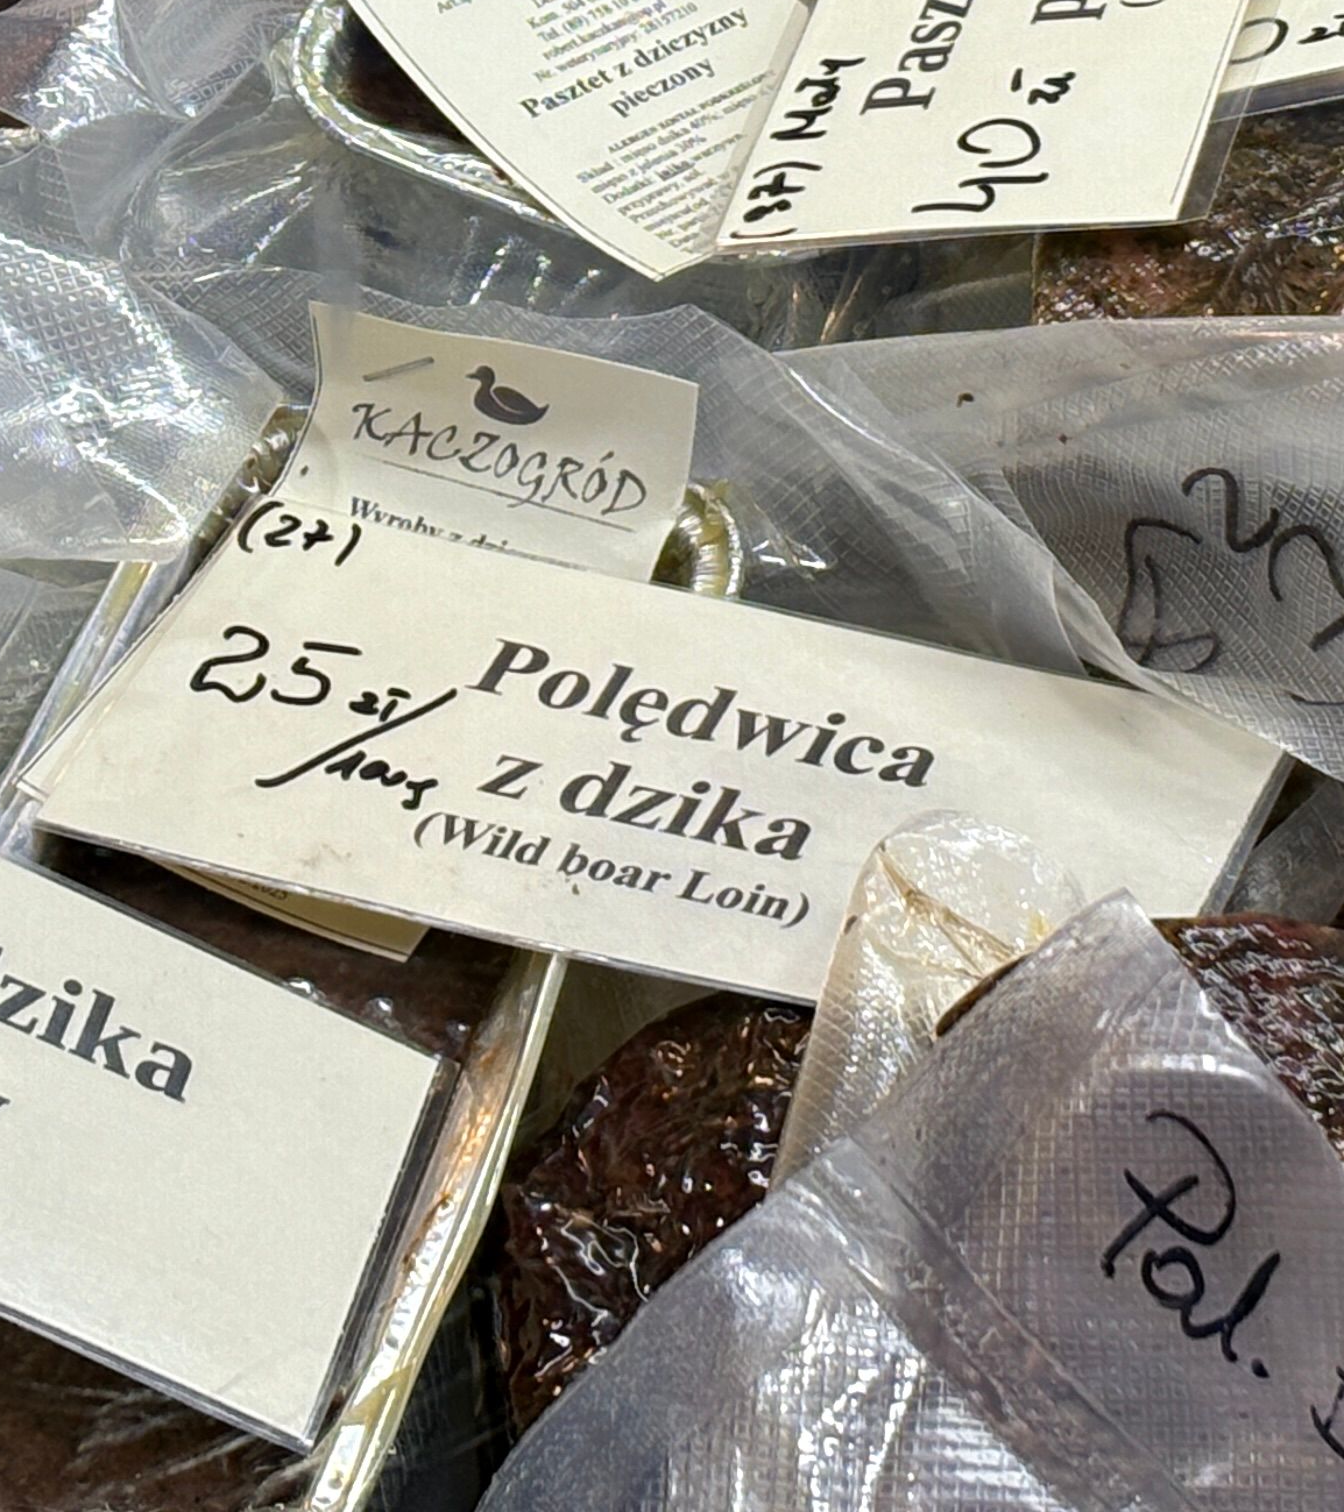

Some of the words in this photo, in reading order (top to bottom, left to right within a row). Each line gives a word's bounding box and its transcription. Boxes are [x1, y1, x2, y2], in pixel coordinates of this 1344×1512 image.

[519, 69, 614, 119] Pasztet
[614, 62, 633, 78] z
[633, 7, 749, 68] dziczyzny
[608, 58, 716, 119] pieczony
[912, 119, 1048, 212] 40
[352, 402, 647, 517] KACZOGRÓD
[238, 495, 361, 566] (27)
[190, 626, 362, 706] 25
[467, 640, 934, 787] Polędwica
[478, 755, 537, 799] z
[560, 762, 811, 860] dzika
[414, 813, 551, 865] (Wild
[558, 843, 672, 890] boar
[678, 870, 809, 928] Loin)
